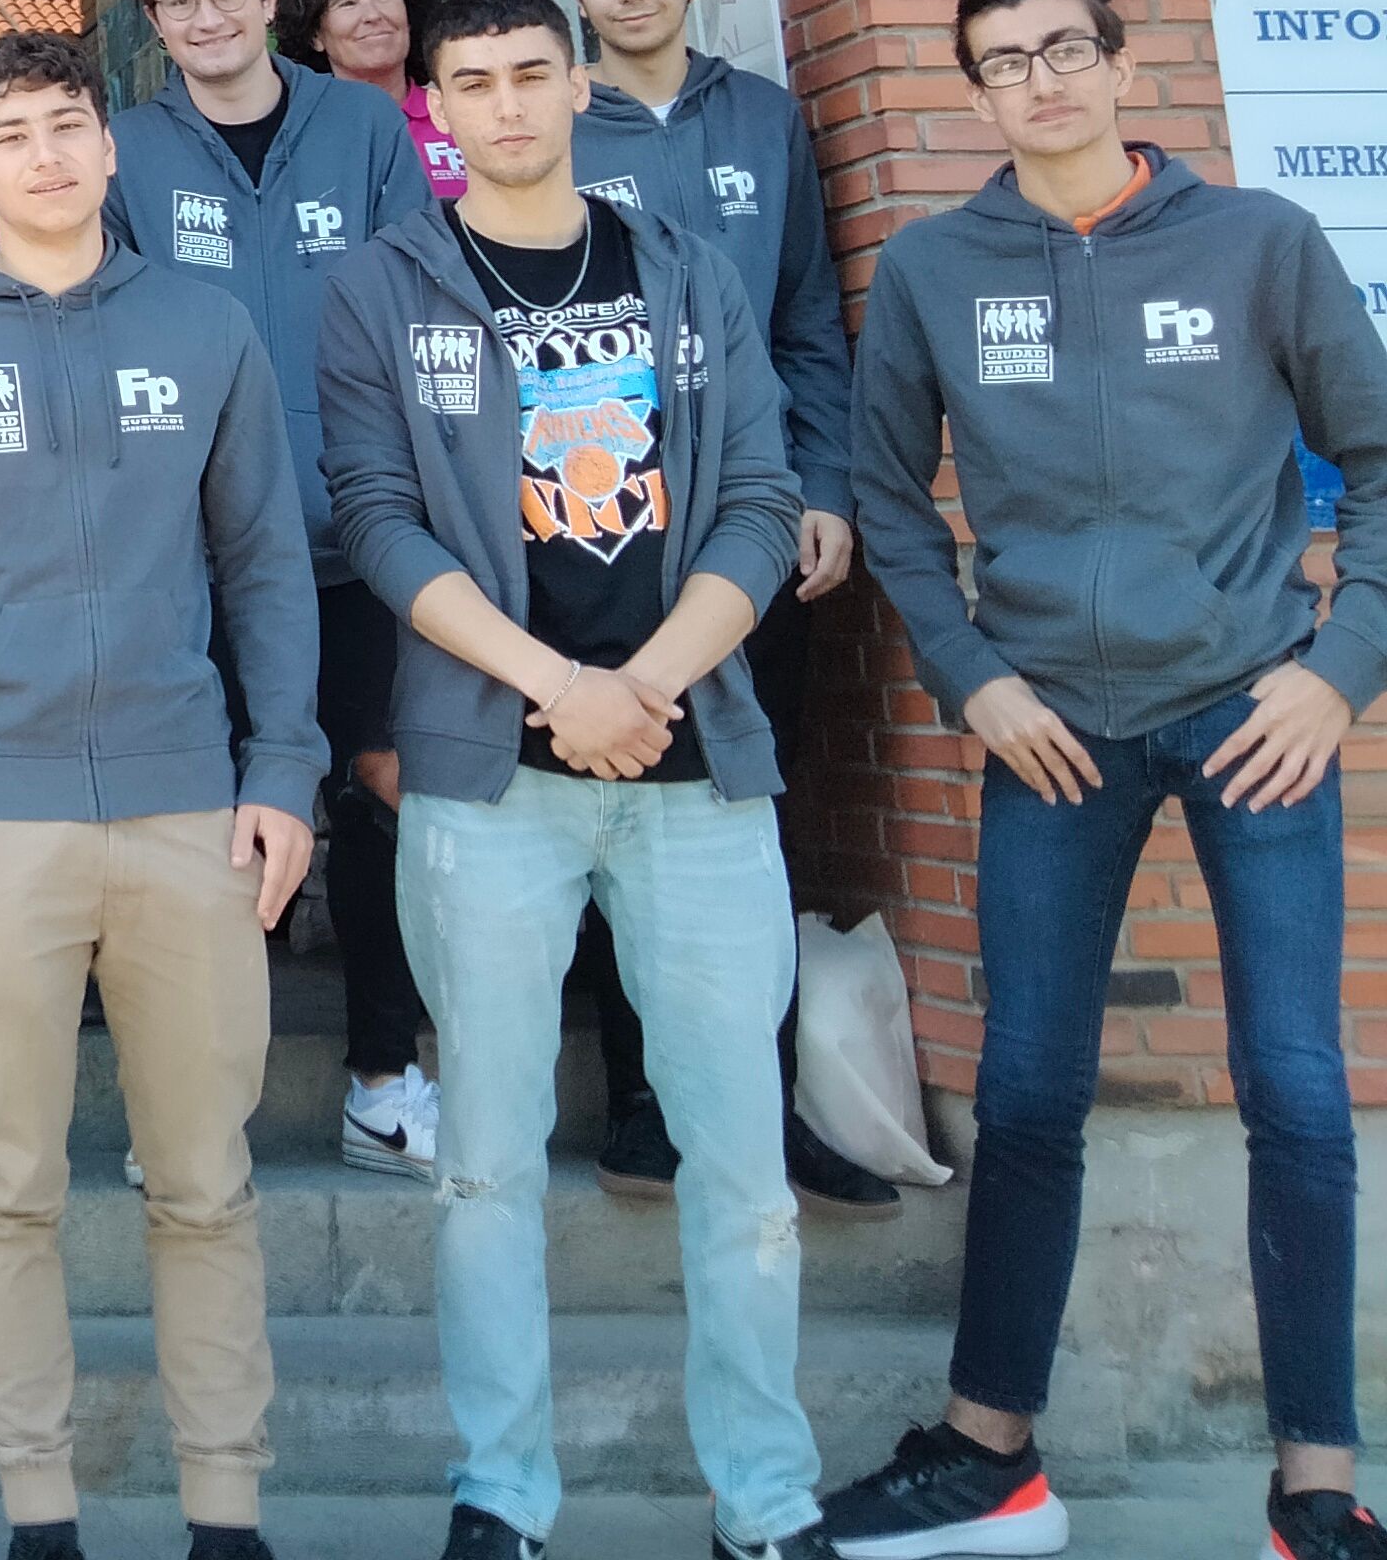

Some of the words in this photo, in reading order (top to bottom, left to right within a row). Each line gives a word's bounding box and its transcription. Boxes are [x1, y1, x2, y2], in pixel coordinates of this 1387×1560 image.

[1253, 9, 1387, 41] INFO
[296, 201, 342, 238] Fp
[179, 235, 227, 248] CIUDAD
[1143, 300, 1213, 346] Fp
[985, 350, 1047, 359] CIUDAD
[985, 362, 1047, 375] JARDÍN
[117, 368, 178, 414] Fp
